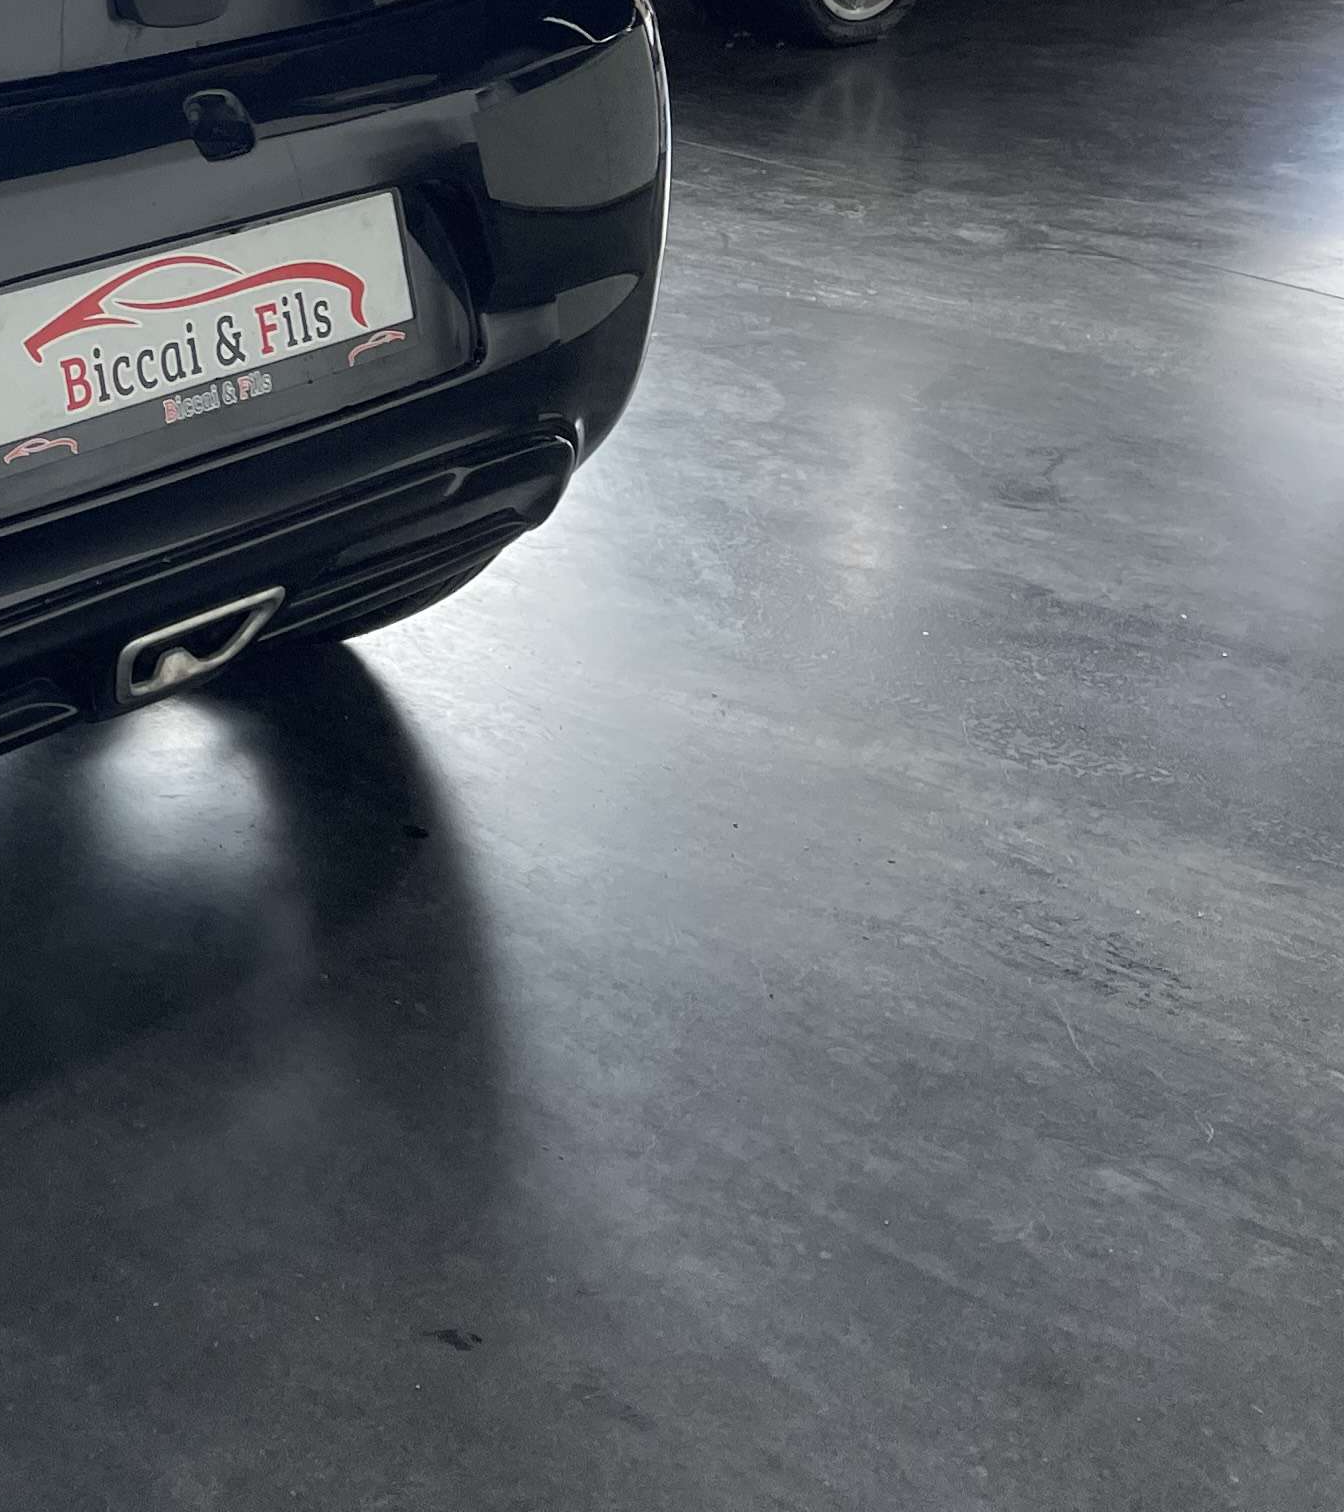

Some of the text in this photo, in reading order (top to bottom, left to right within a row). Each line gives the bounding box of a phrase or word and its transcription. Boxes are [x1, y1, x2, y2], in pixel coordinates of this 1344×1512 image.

[60, 292, 333, 412] Biccai & Fils
[162, 370, 272, 424] Biccai & Fils
